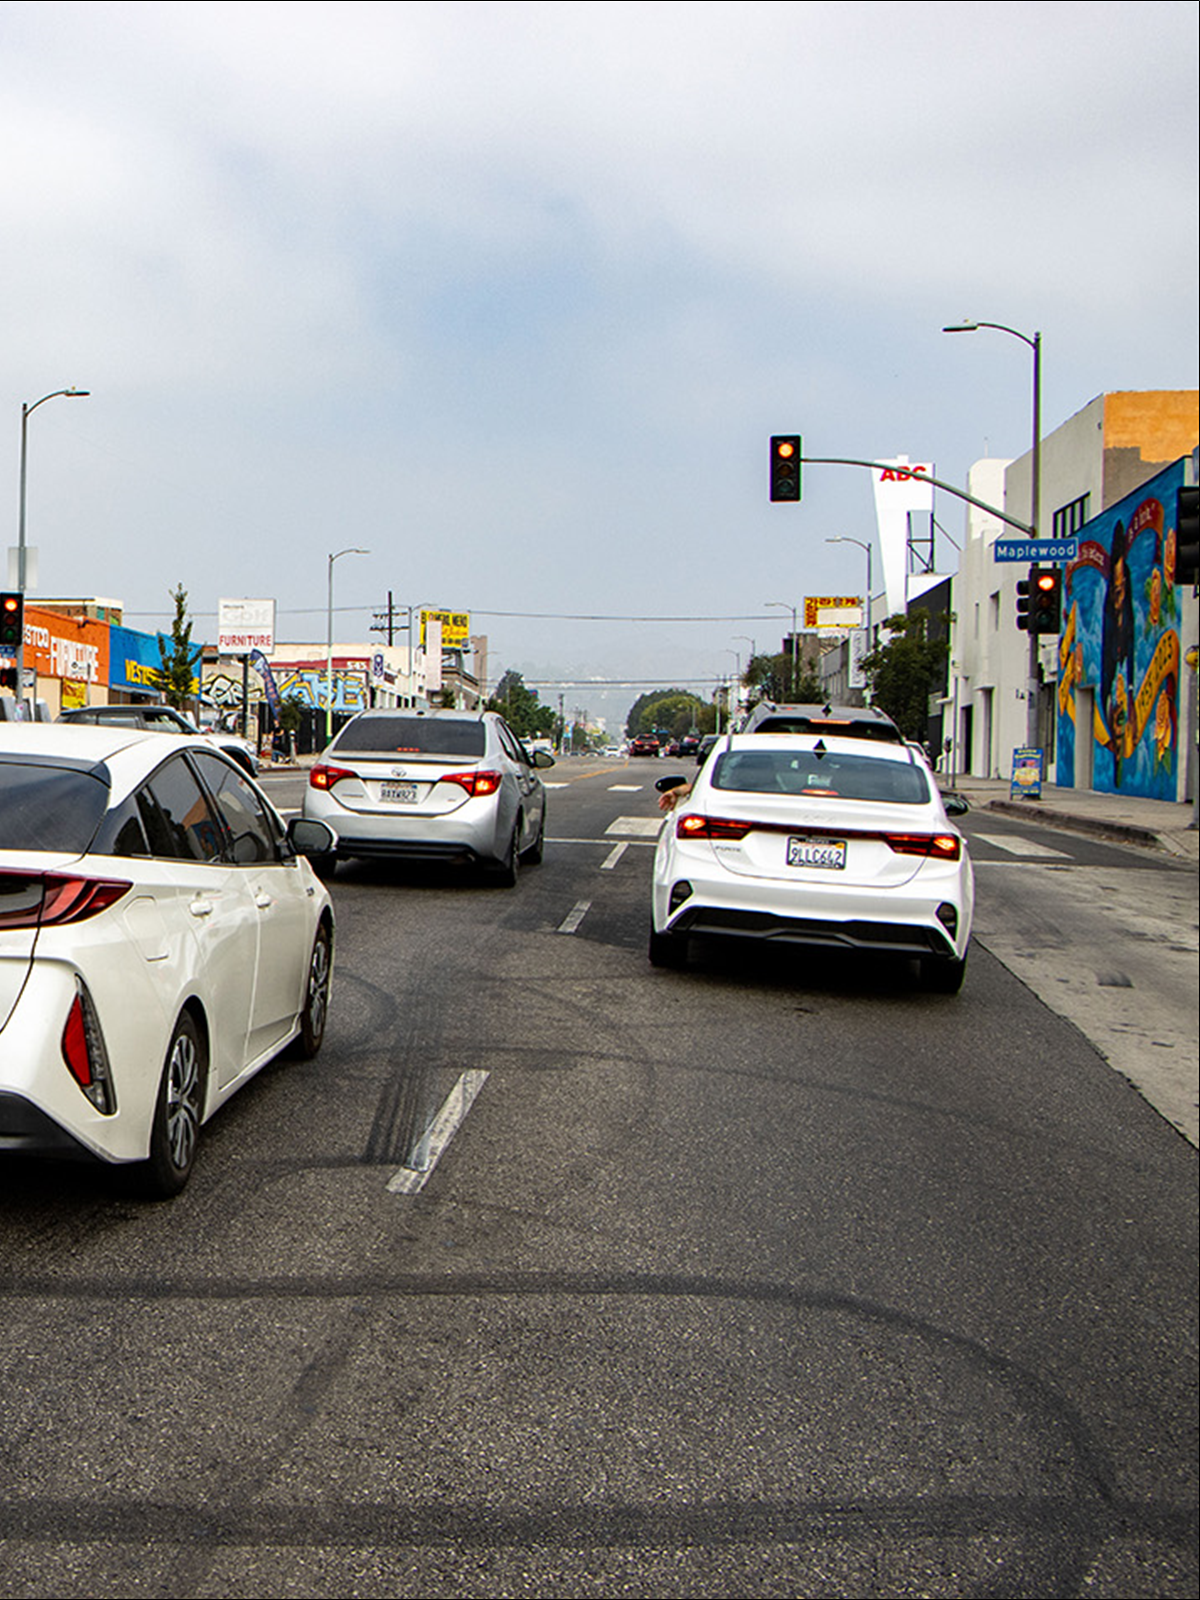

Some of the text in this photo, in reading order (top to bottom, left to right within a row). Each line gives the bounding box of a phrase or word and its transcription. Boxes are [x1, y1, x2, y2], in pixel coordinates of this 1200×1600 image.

[879, 465, 927, 482] ABC
[996, 543, 1075, 559] Maplewood
[218, 634, 272, 647] FURNITURE
